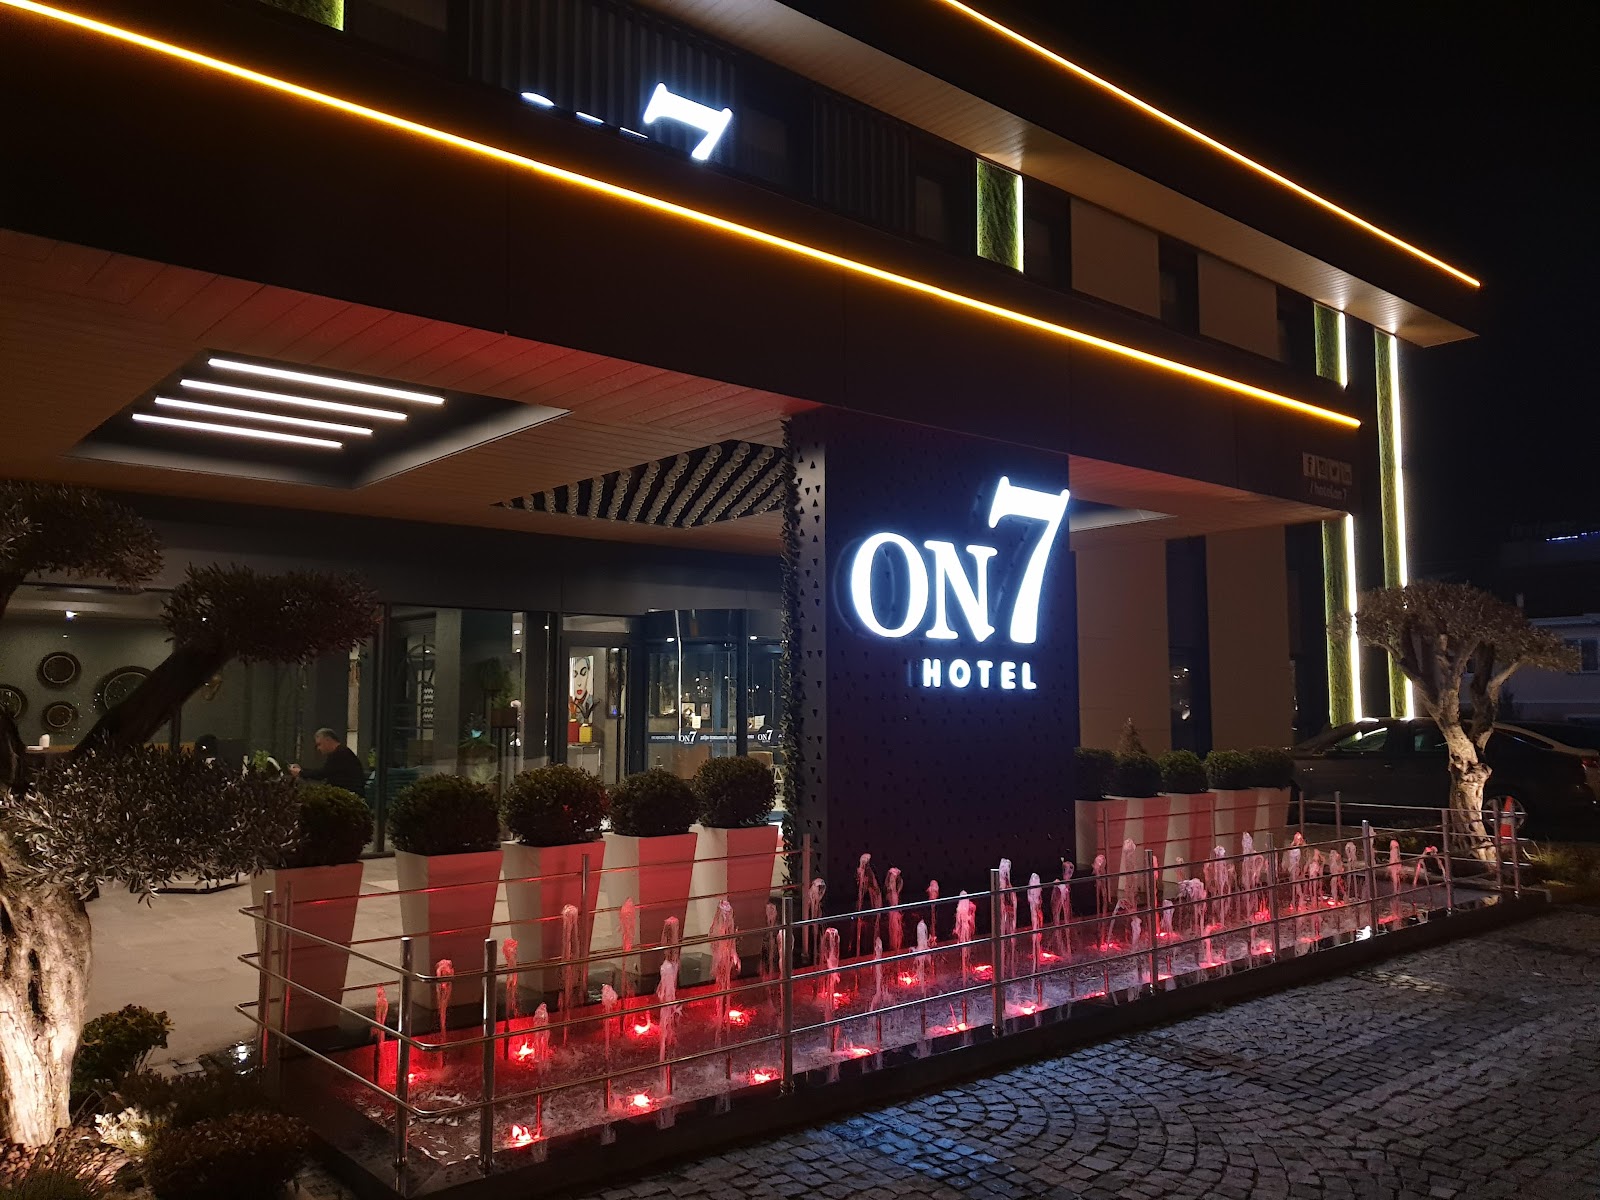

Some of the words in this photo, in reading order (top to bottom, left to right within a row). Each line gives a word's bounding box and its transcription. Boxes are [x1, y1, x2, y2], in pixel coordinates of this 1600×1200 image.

[851, 476, 1071, 644] ON7
[922, 658, 1037, 690] HOTEL
[757, 729, 773, 741] ON7
